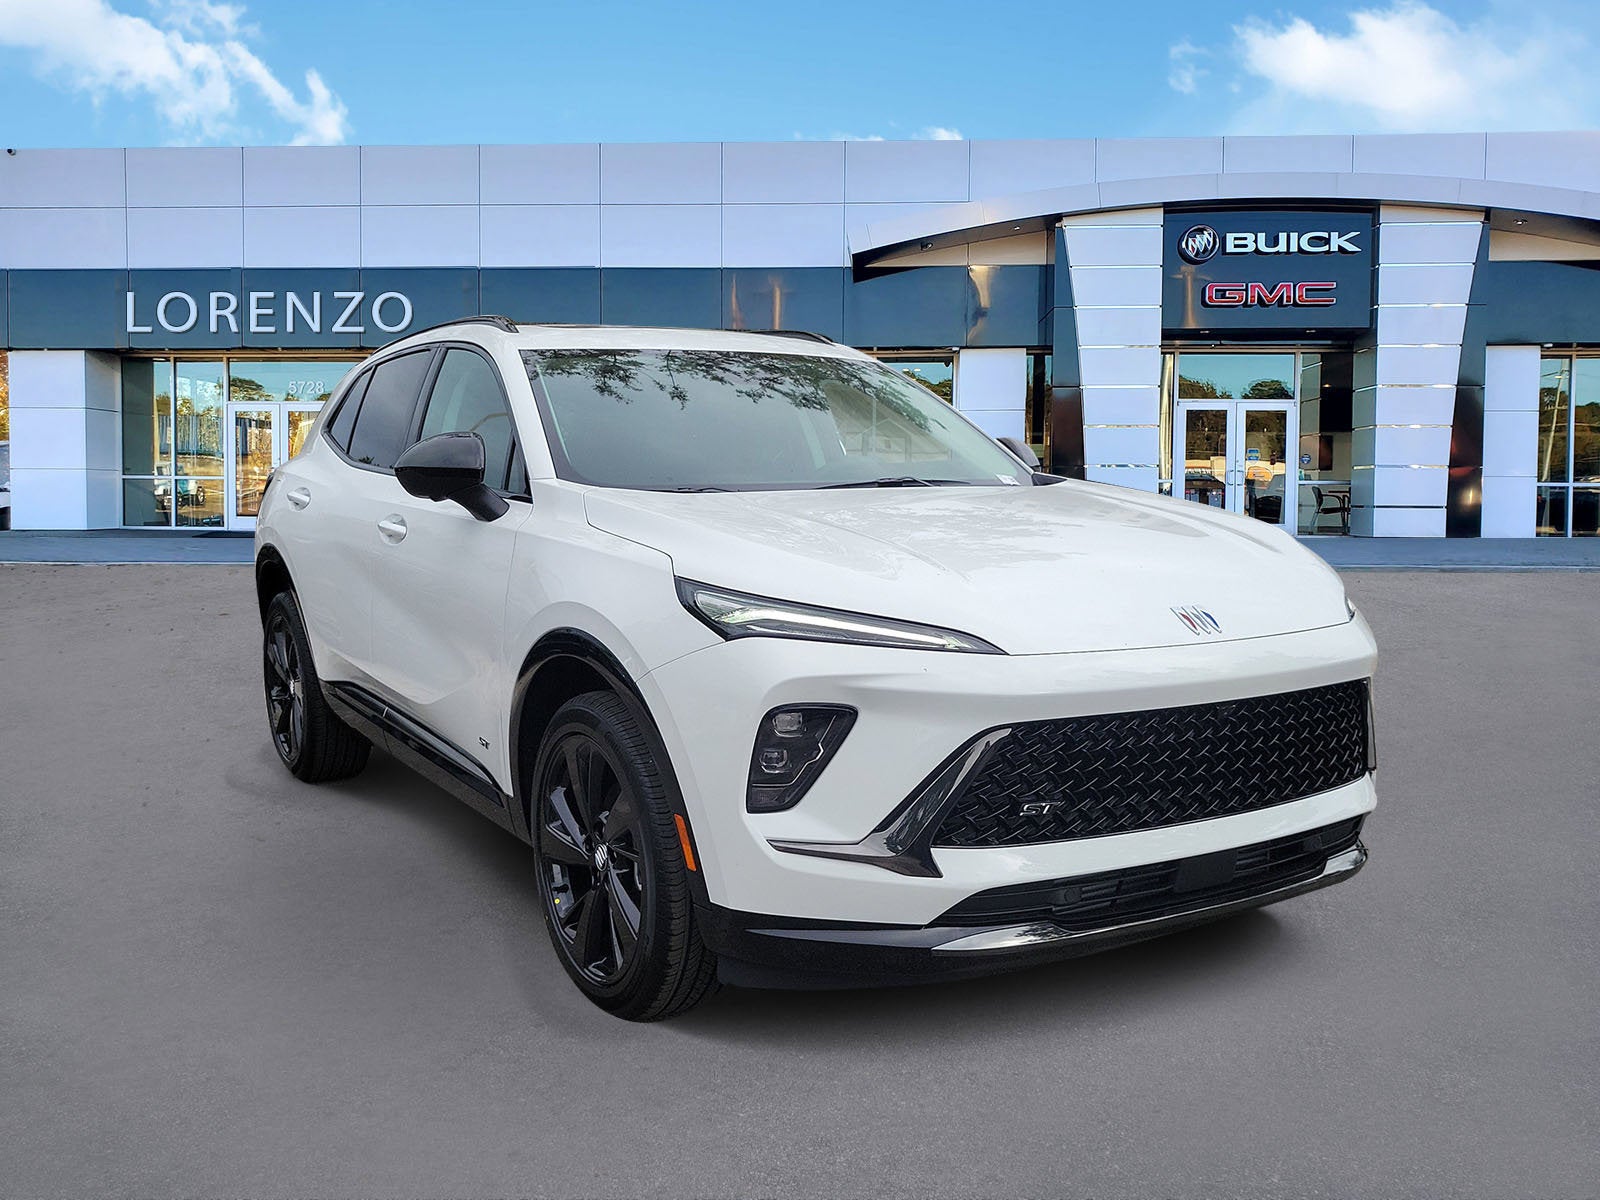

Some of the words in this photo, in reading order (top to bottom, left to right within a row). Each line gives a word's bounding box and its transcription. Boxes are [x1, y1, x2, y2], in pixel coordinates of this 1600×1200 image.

[1226, 231, 1362, 253] BUICK
[1205, 281, 1337, 305] GMC
[126, 291, 413, 334] LORENZO
[288, 380, 325, 394] 5728
